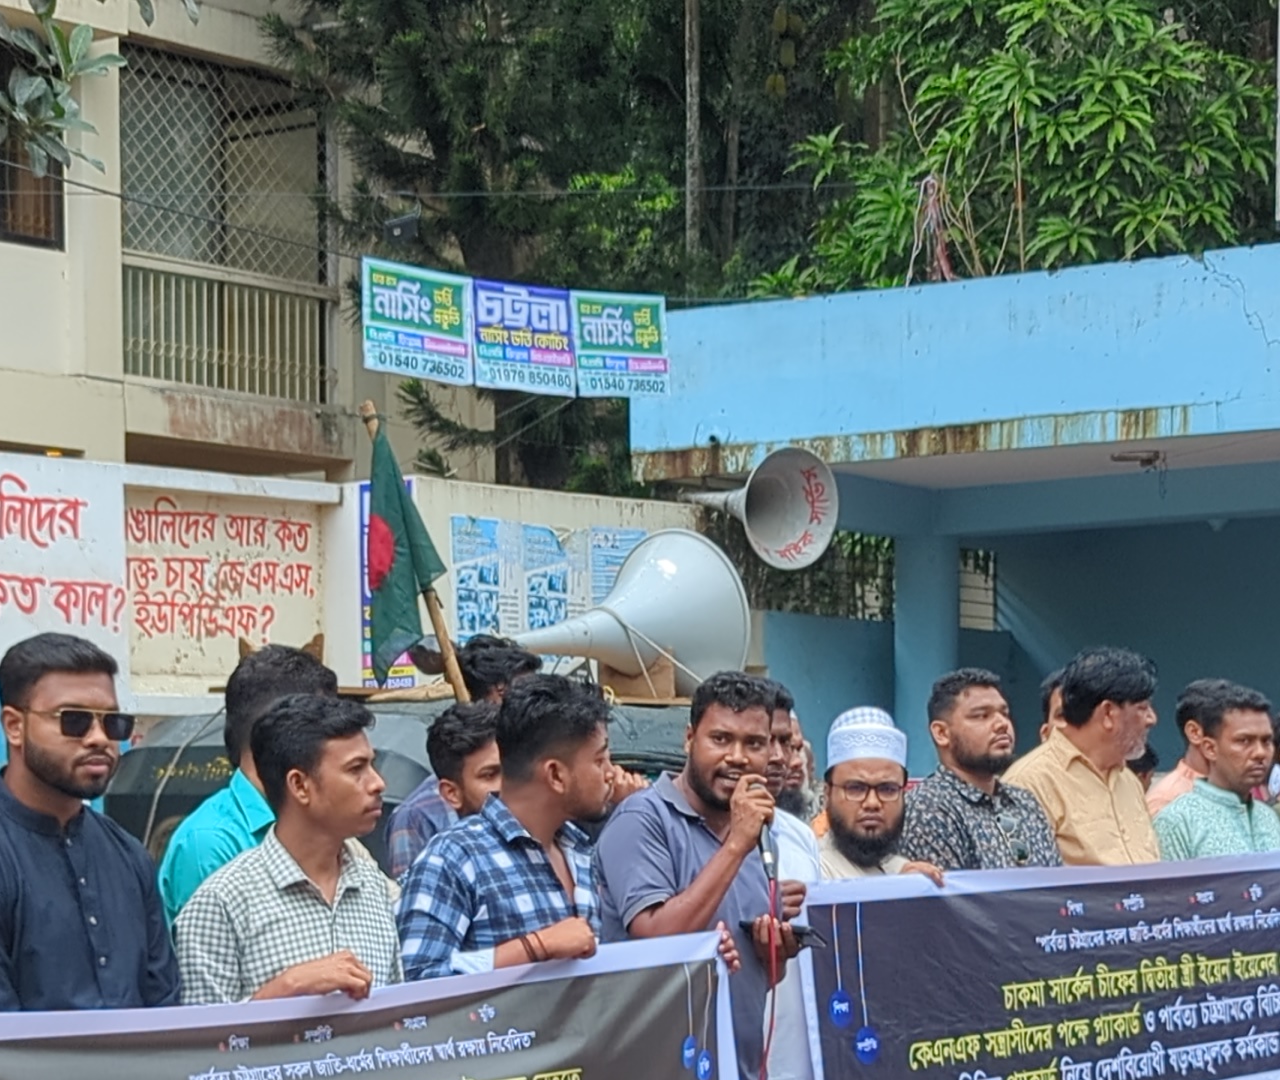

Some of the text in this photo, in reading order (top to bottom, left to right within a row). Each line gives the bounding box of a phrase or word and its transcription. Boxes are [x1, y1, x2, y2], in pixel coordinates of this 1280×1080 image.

[373, 280, 432, 326] নার্সিং
[581, 306, 635, 348] নার্সিং
[379, 352, 419, 370] 01540
[125, 496, 312, 553] াঙালিদের আর কত
[164, 557, 210, 594] চায়
[50, 579, 127, 634] কাল?
[1002, 981, 1046, 1011] চাকমা
[1048, 966, 1095, 1001] সার্কেল
[1096, 963, 1138, 998] চীফের
[1140, 955, 1178, 992] দ্বিতীয়
[908, 1033, 981, 1071] কেএনএফ
[1056, 1017, 1090, 1048] পক্ষে
[1144, 1012, 1156, 1033] ও
[1158, 996, 1197, 1032] পার্বত্য
